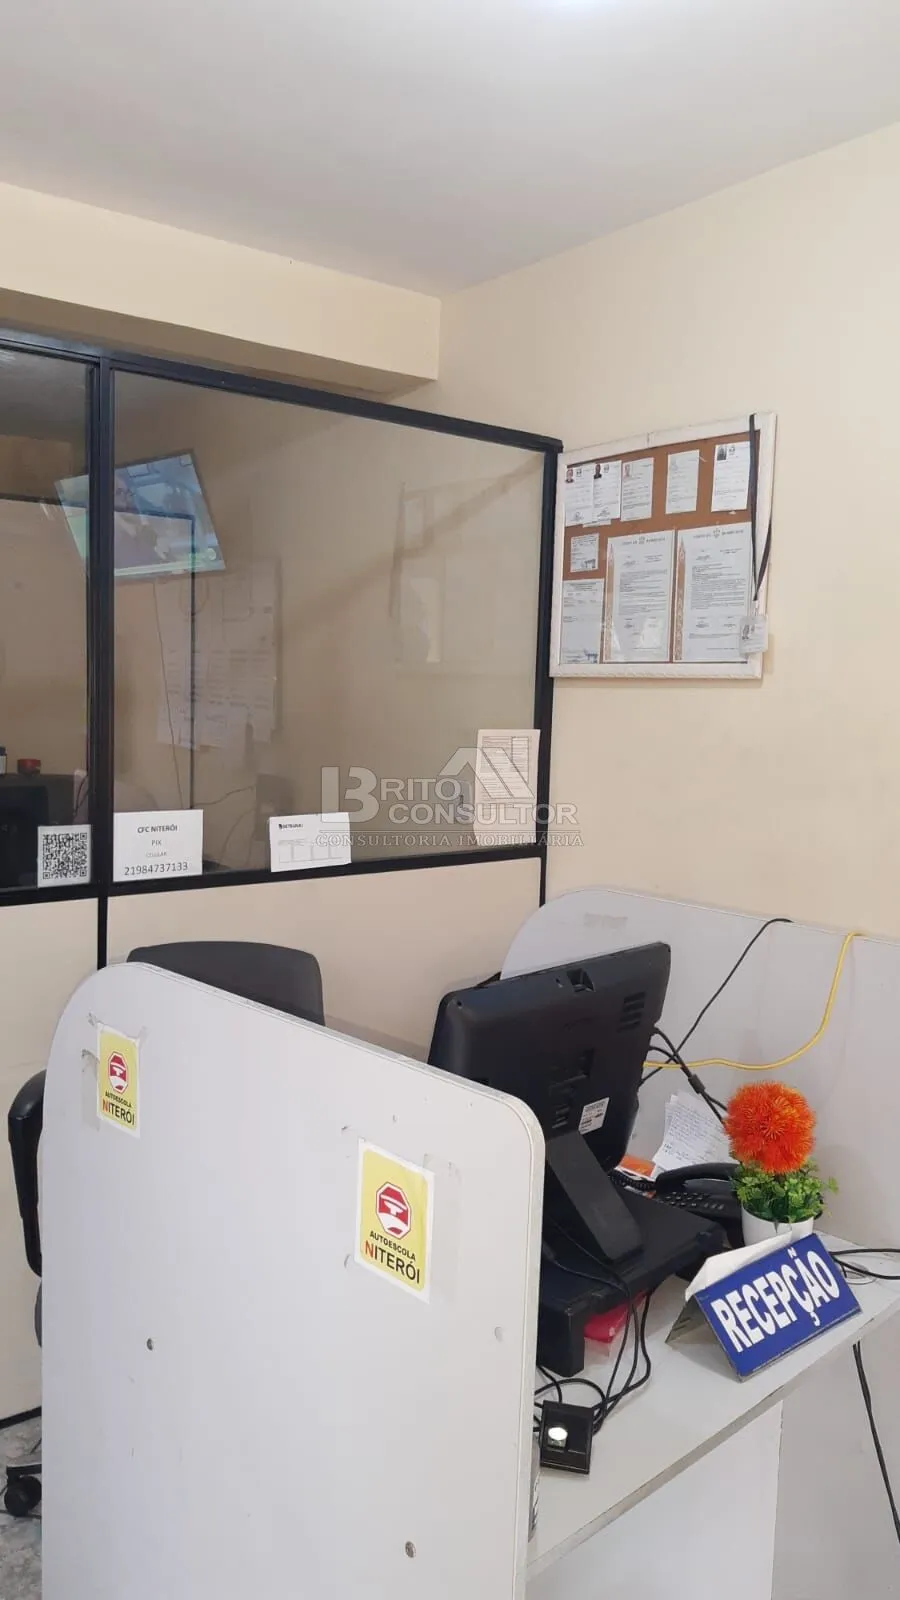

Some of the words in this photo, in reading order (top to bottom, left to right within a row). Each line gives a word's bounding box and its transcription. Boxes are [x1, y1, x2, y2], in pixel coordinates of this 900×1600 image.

[151, 824, 178, 832] NITERÓI
[151, 839, 162, 847] PIX
[124, 861, 189, 876] 21984737133
[105, 1090, 132, 1108] AUTOESCOLA
[102, 1098, 135, 1125] NITERÓI
[369, 1230, 416, 1261] AUTOESCOLA
[364, 1240, 421, 1284] NITERÓI
[710, 1247, 841, 1353] RECEPÇÃO
